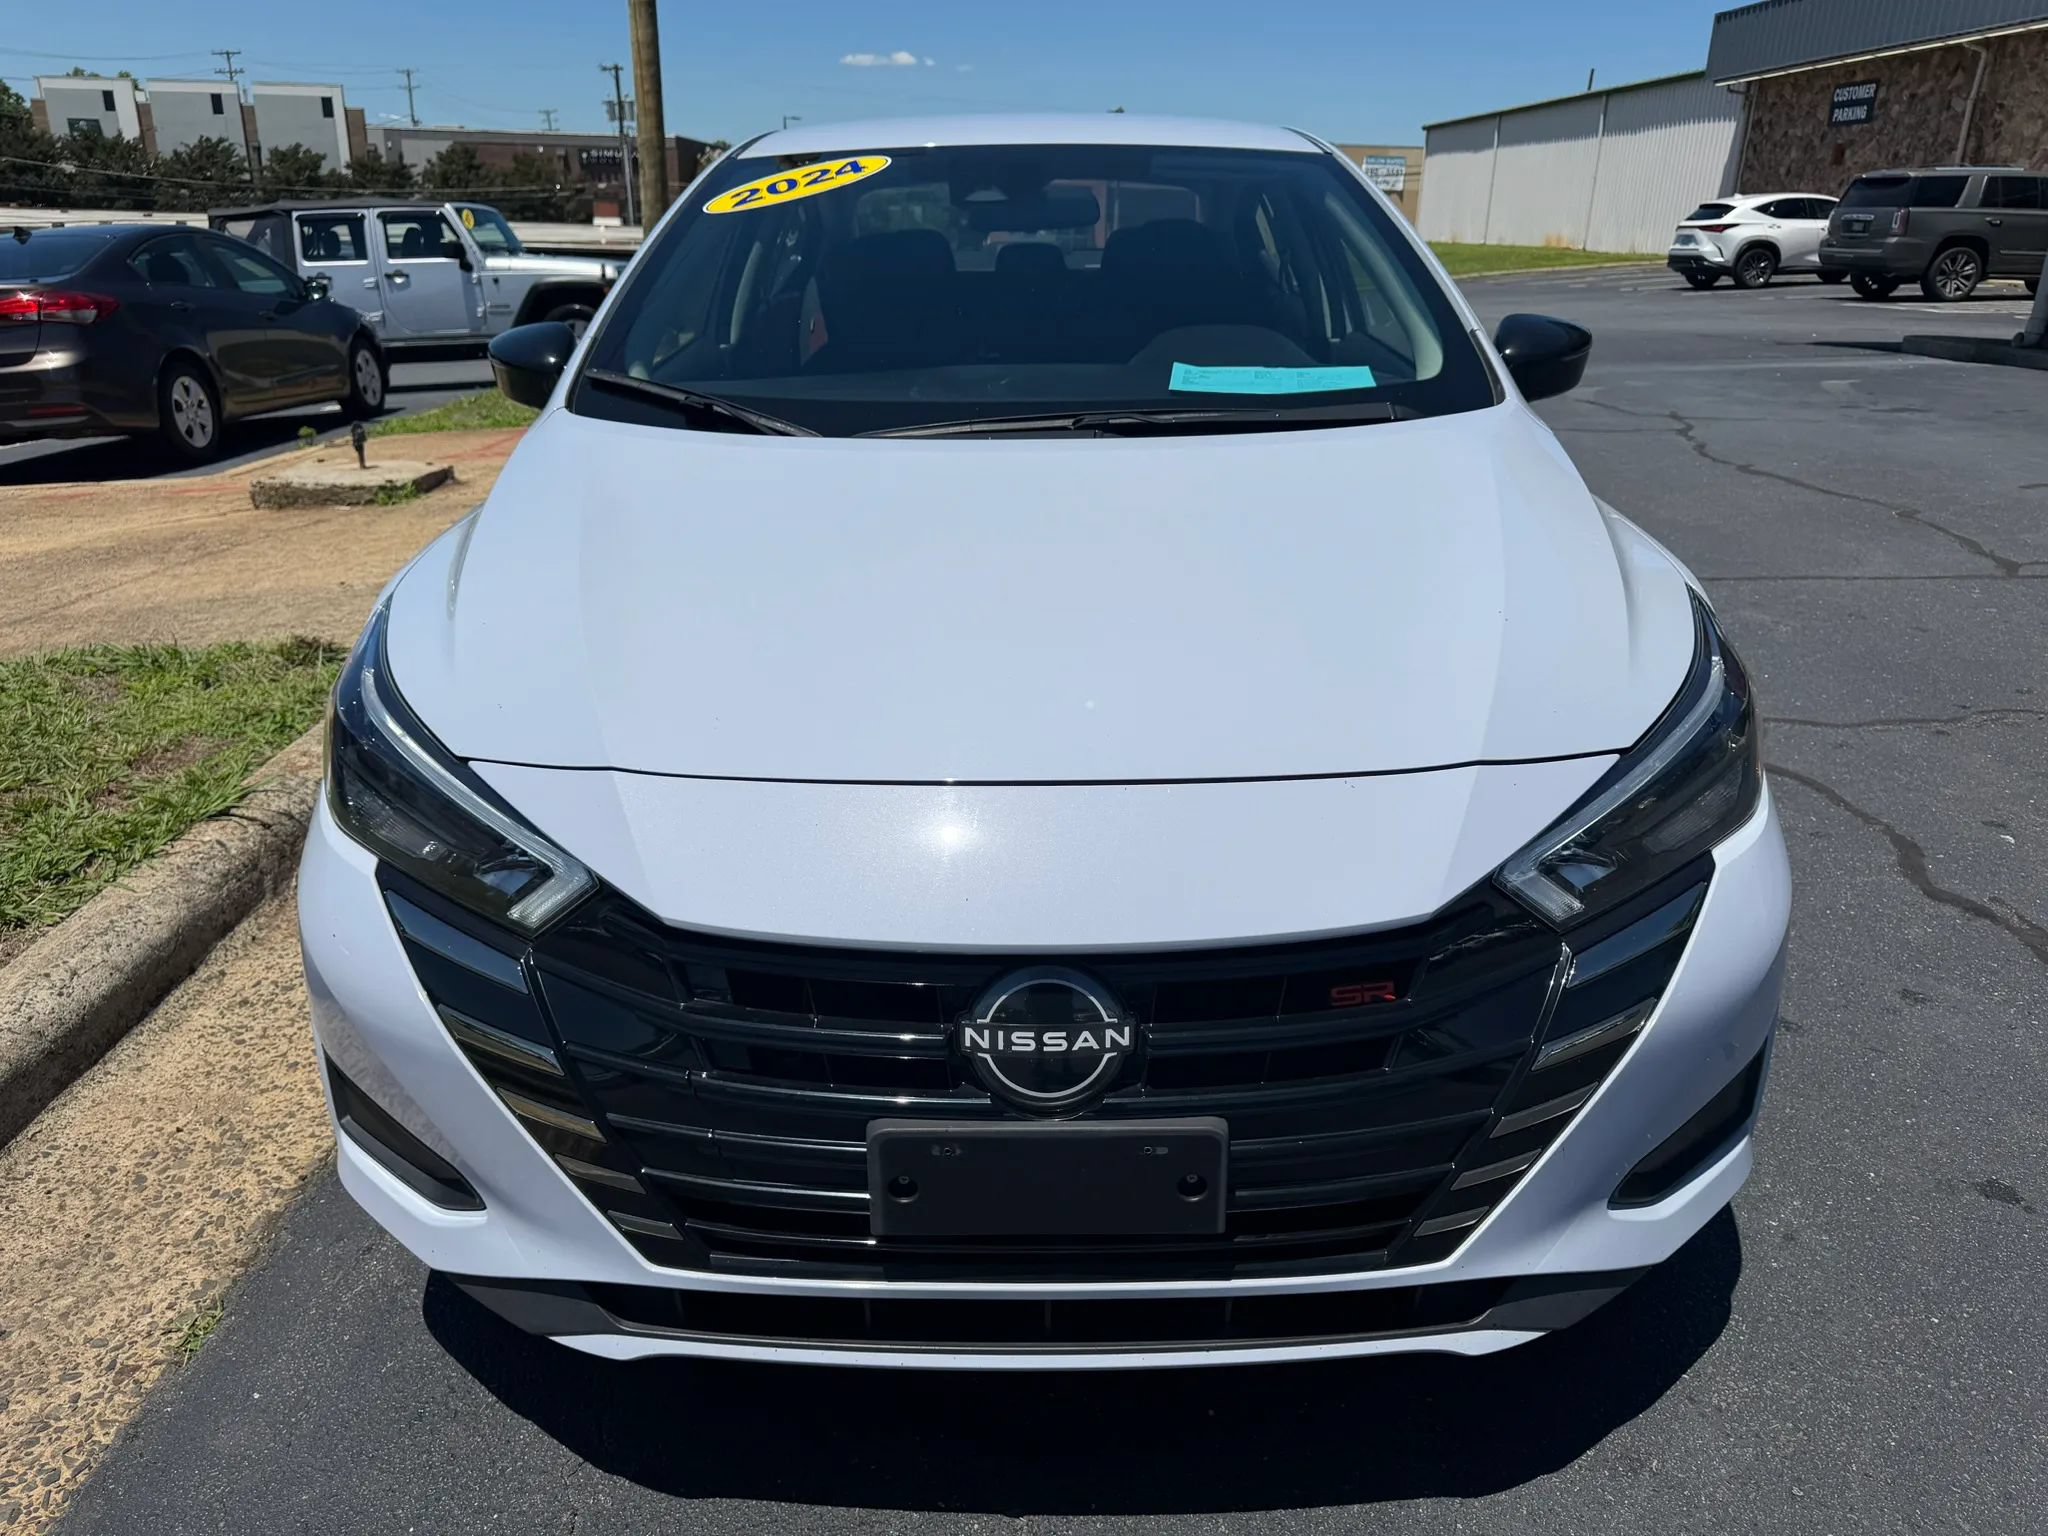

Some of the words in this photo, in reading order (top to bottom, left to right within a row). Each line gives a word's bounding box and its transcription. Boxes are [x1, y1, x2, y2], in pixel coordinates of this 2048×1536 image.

[1834, 83, 1876, 102] CUSTOMER
[1832, 105, 1867, 122] PARKING
[730, 160, 868, 209] 2024
[1331, 981, 1396, 1006] SR
[965, 1026, 1130, 1052] NISSAN
